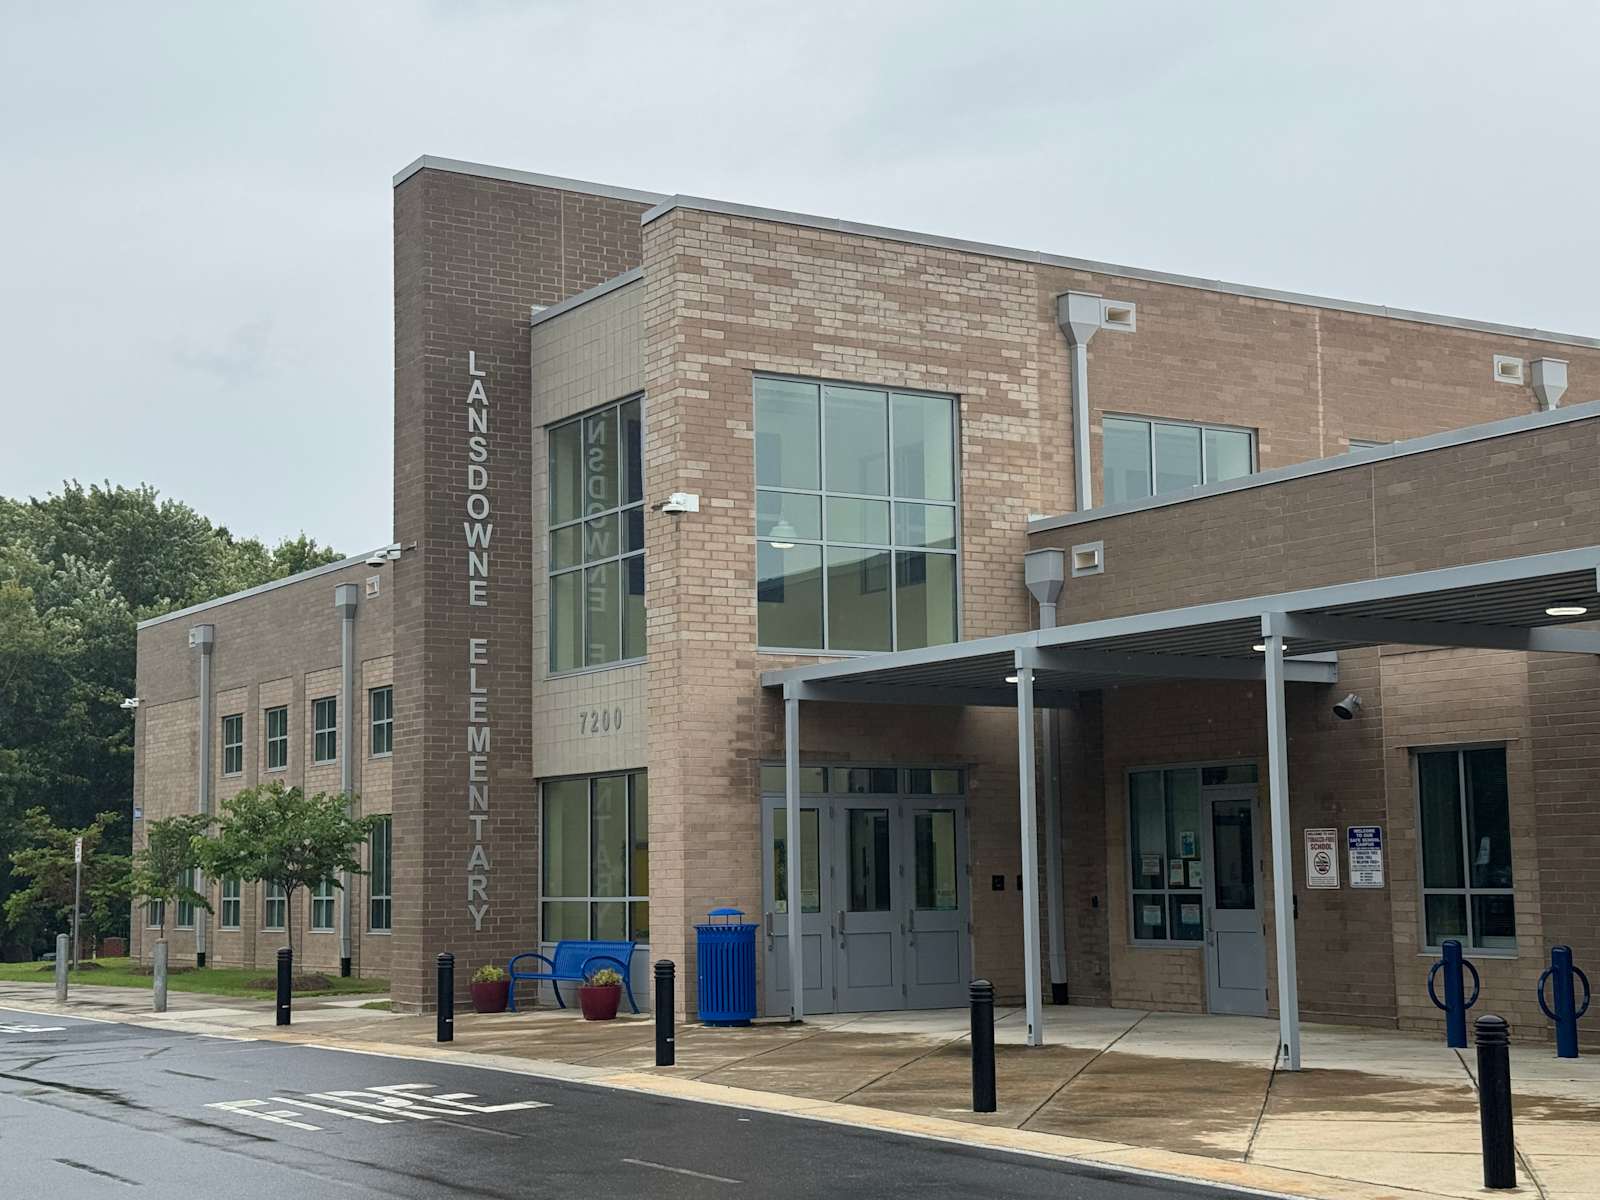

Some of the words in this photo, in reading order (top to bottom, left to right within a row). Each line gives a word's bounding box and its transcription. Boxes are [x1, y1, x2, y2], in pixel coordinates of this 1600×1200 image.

[464, 350, 493, 607] LANSDOWNE
[467, 638, 491, 932] ELEMENTARY
[579, 708, 622, 735] 7200
[203, 1083, 553, 1131] FIRE
